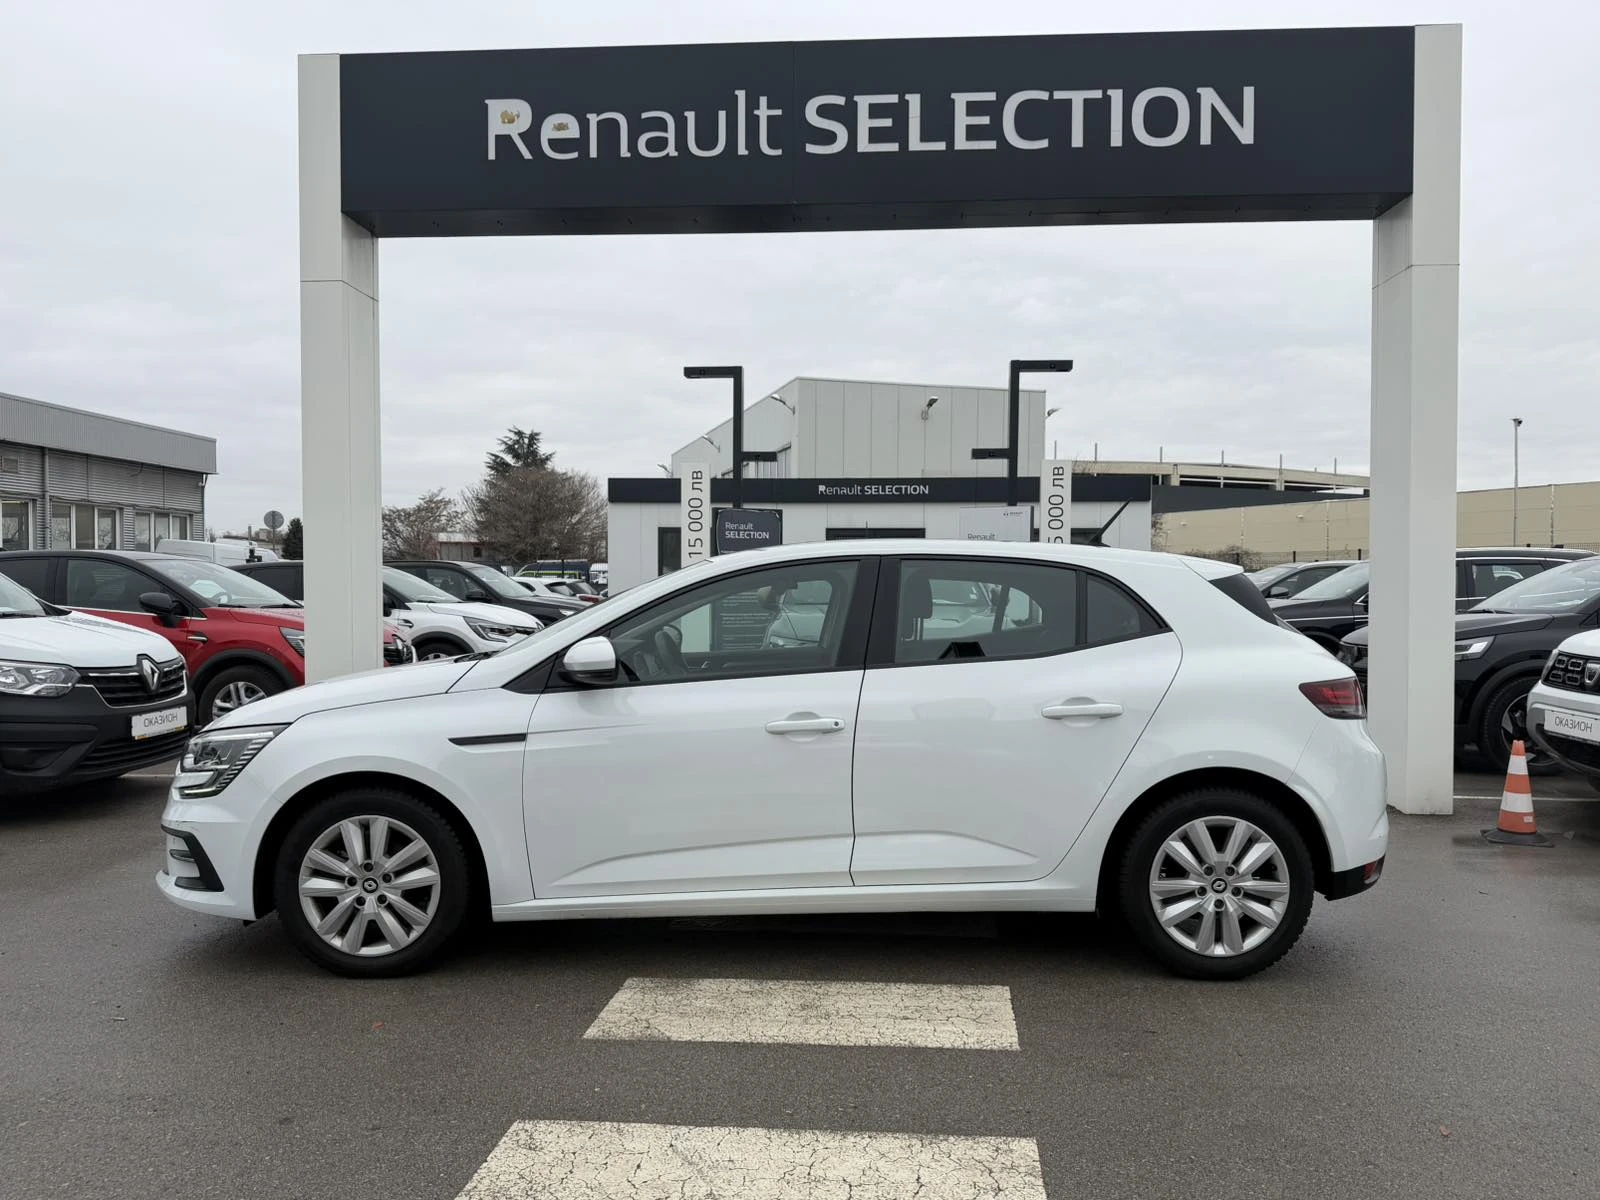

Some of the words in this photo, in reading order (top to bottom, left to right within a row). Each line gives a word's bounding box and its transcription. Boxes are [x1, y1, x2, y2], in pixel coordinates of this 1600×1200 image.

[484, 88, 782, 161] Renault
[804, 85, 1255, 155] SELECTION
[818, 484, 862, 495] Renault
[864, 485, 929, 495] SELECTION
[687, 497, 703, 532] 000
[1048, 494, 1064, 530] 000
[725, 522, 754, 530] Renault
[725, 530, 770, 539] SELECTION
[687, 538, 703, 558] 15
[143, 712, 178, 727] ОКАЗИОН
[1554, 716, 1593, 733] ОКАЗИОН
